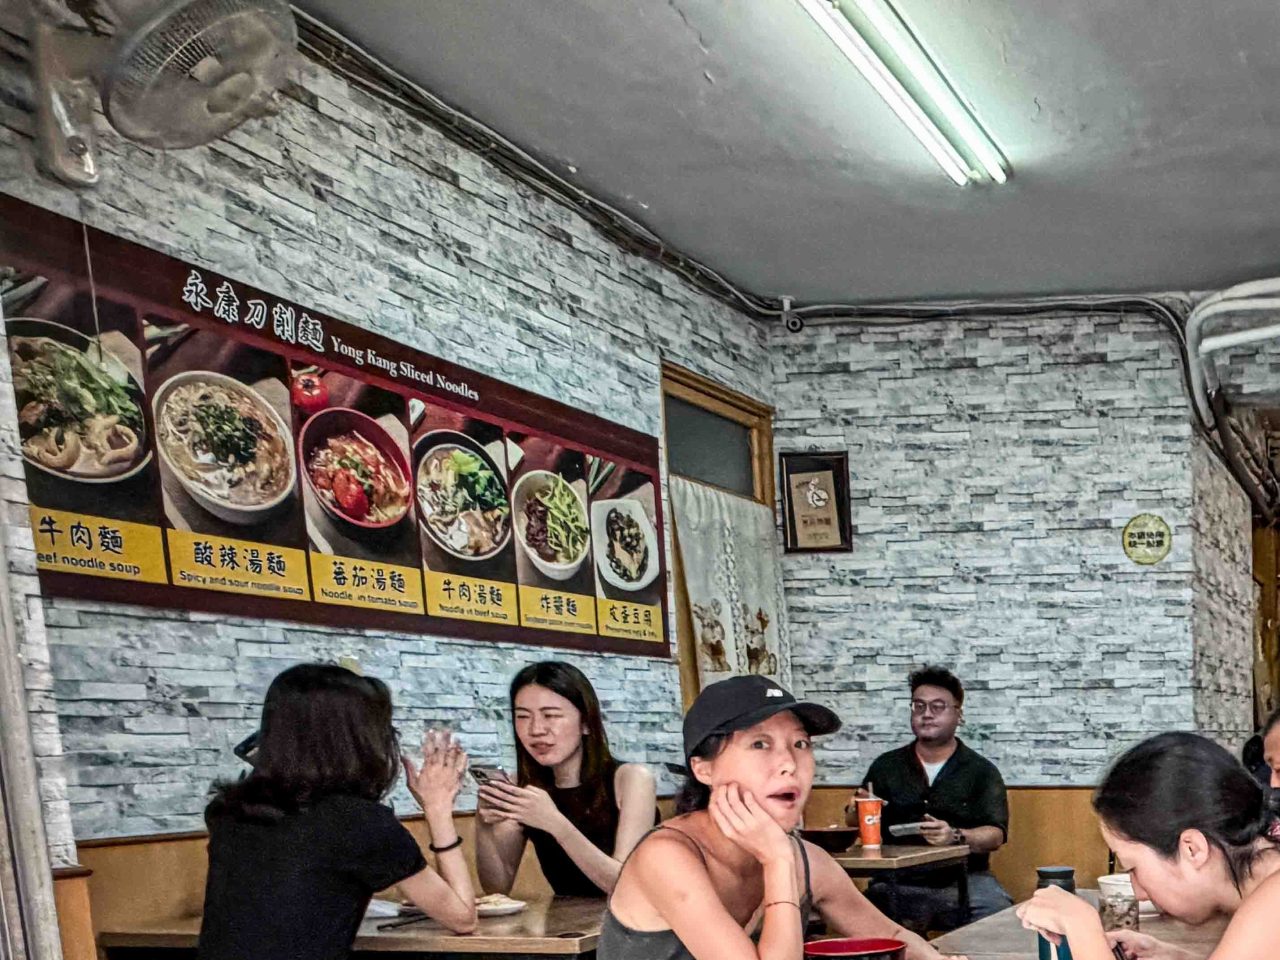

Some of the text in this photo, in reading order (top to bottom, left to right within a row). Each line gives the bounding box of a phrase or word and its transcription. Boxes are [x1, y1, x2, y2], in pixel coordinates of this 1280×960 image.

[182, 270, 325, 352] 永康刀削麵
[330, 336, 480, 401] Yong Kang Sliced Noodles
[39, 515, 123, 555] 牛肉麵
[37, 552, 141, 576] eef noodle soup
[193, 541, 286, 578] 酸辣湯麵
[333, 561, 406, 594] 蕃茄湯麵
[442, 579, 503, 607] 牛肉湯麵
